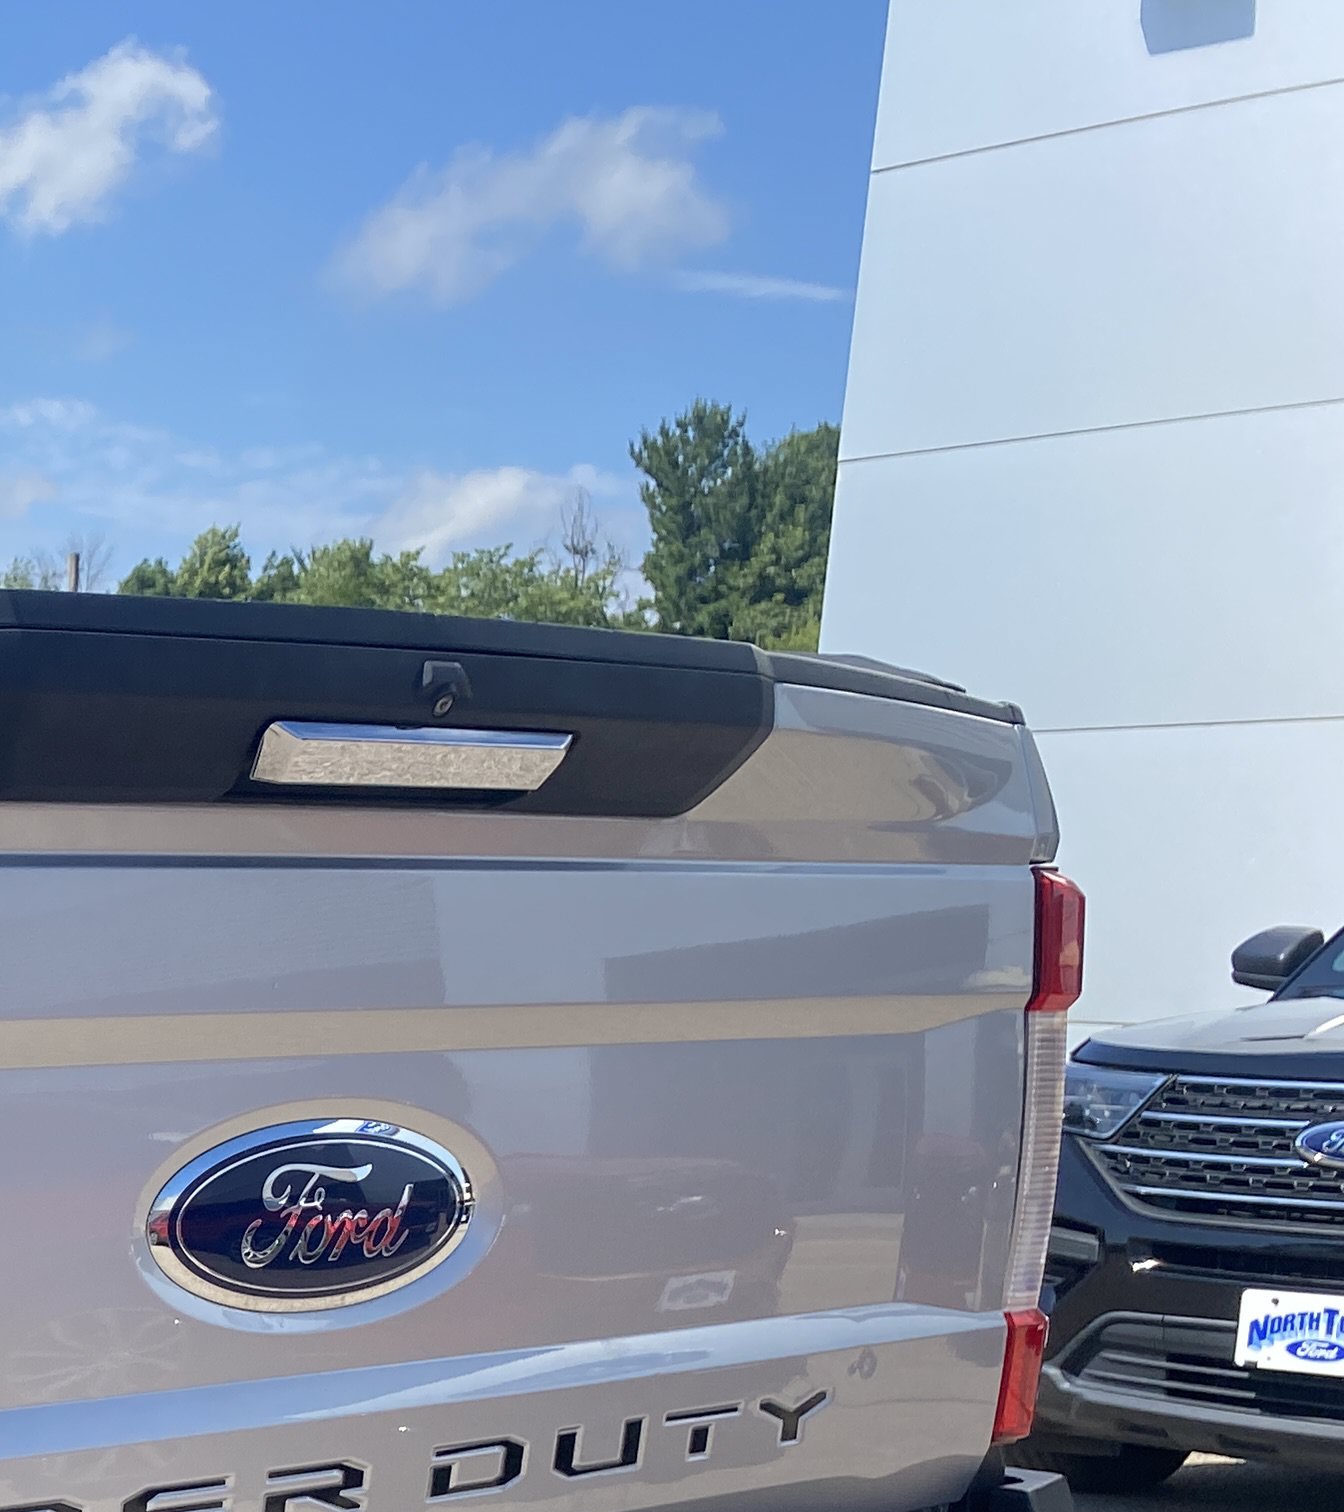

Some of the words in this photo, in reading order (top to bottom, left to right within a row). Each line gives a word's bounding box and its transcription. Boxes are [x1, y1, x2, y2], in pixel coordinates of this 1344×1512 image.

[241, 1163, 414, 1268] Ford
[1296, 1340, 1339, 1360] Ford
[427, 1386, 833, 1503] DUTY
